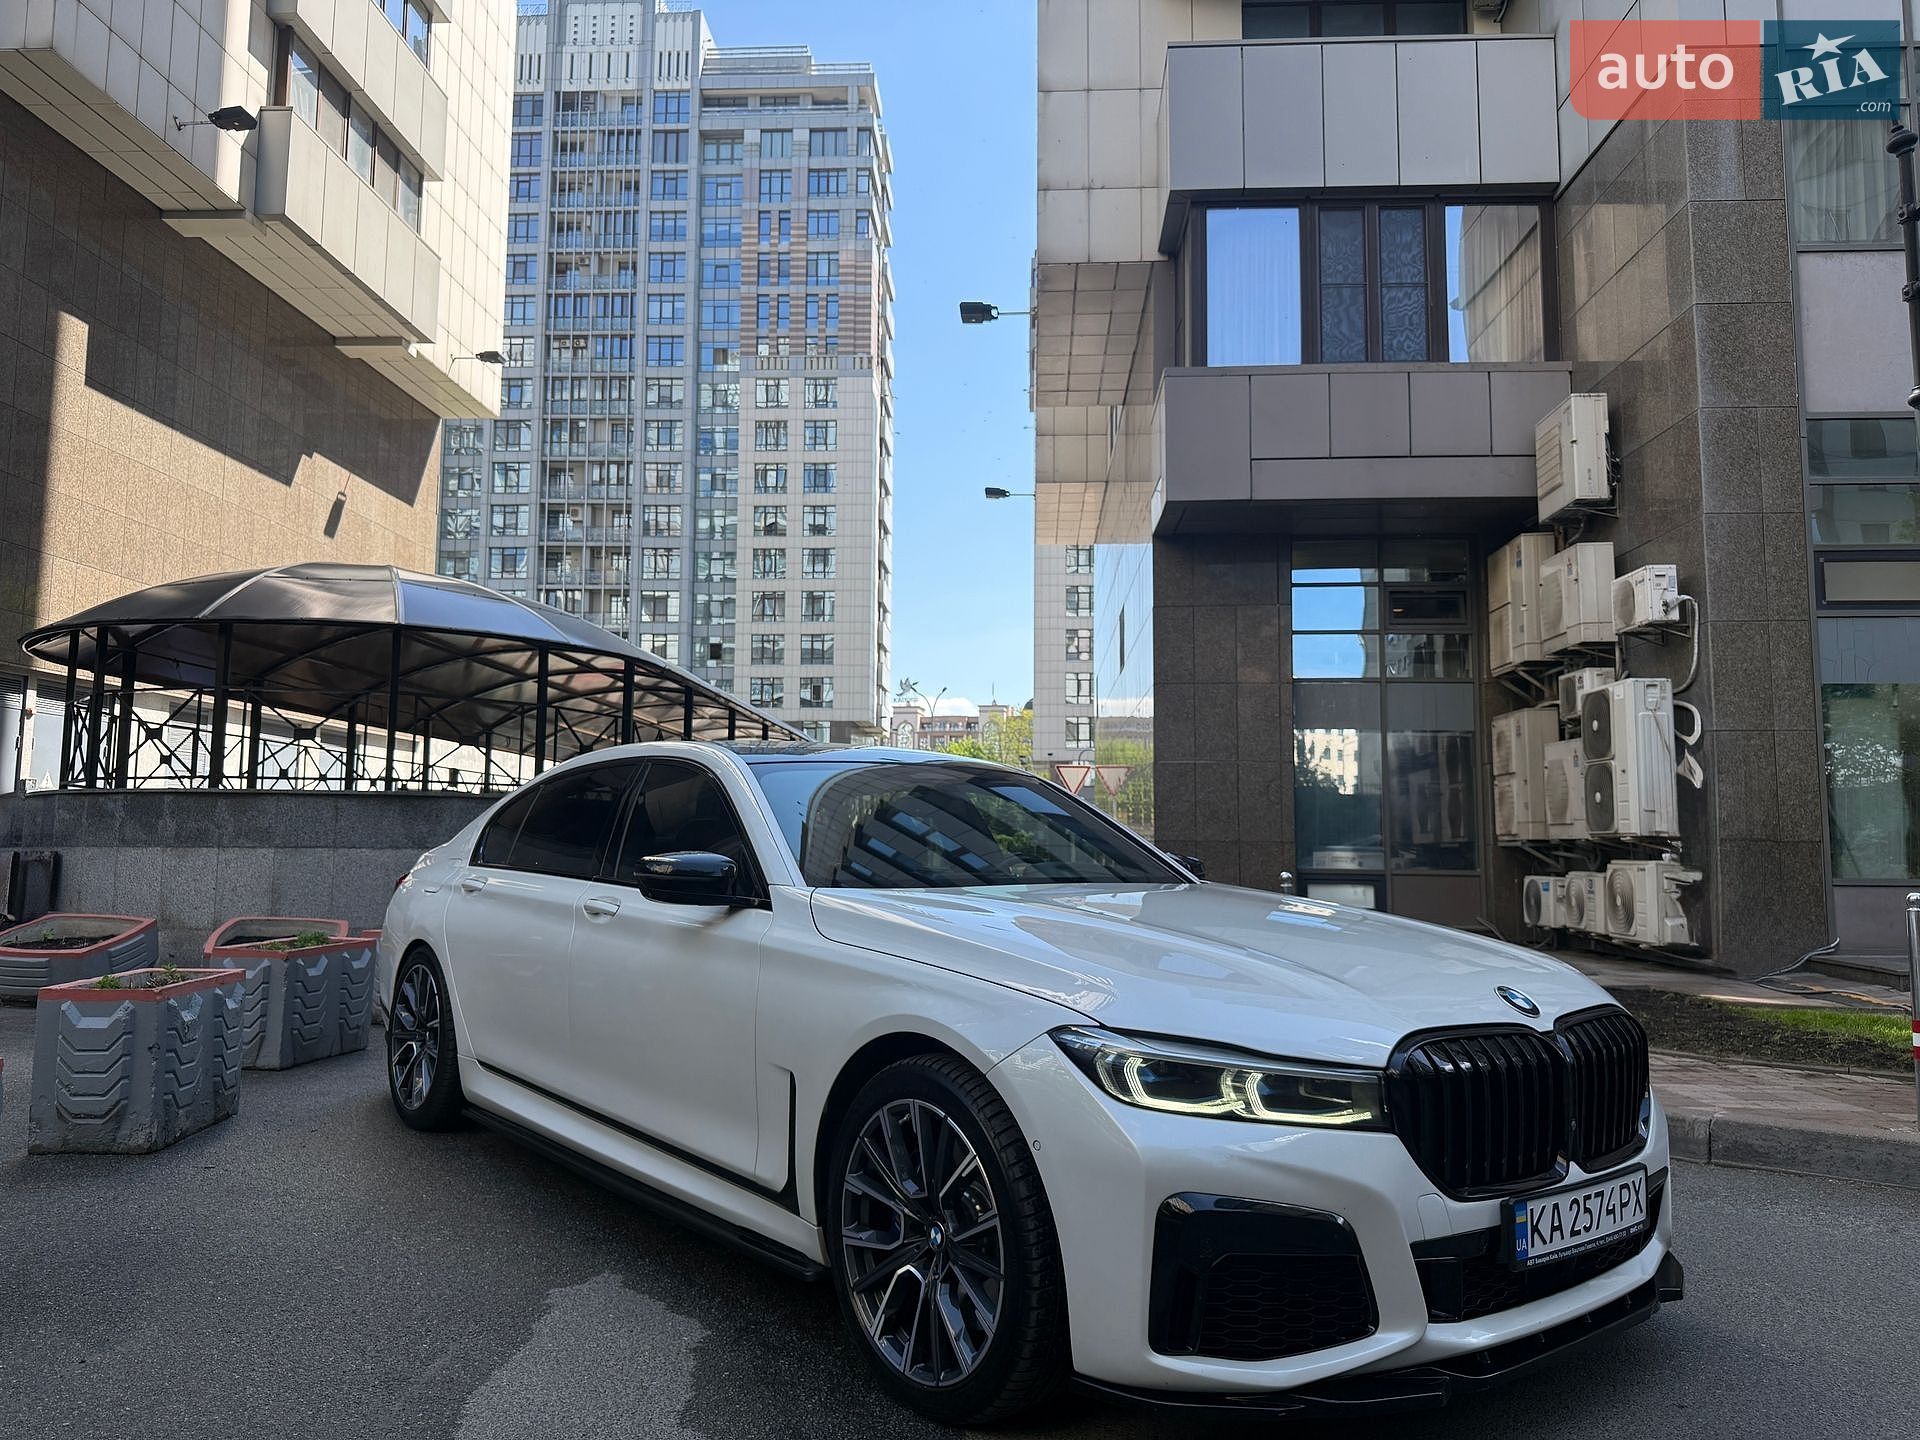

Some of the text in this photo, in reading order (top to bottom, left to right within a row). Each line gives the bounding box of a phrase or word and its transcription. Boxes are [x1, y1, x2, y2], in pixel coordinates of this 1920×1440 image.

[1529, 1202, 1565, 1249] KA
[1568, 1186, 1617, 1238] 2574
[1619, 1177, 1644, 1222] PX
[1516, 1239, 1527, 1252] UA
